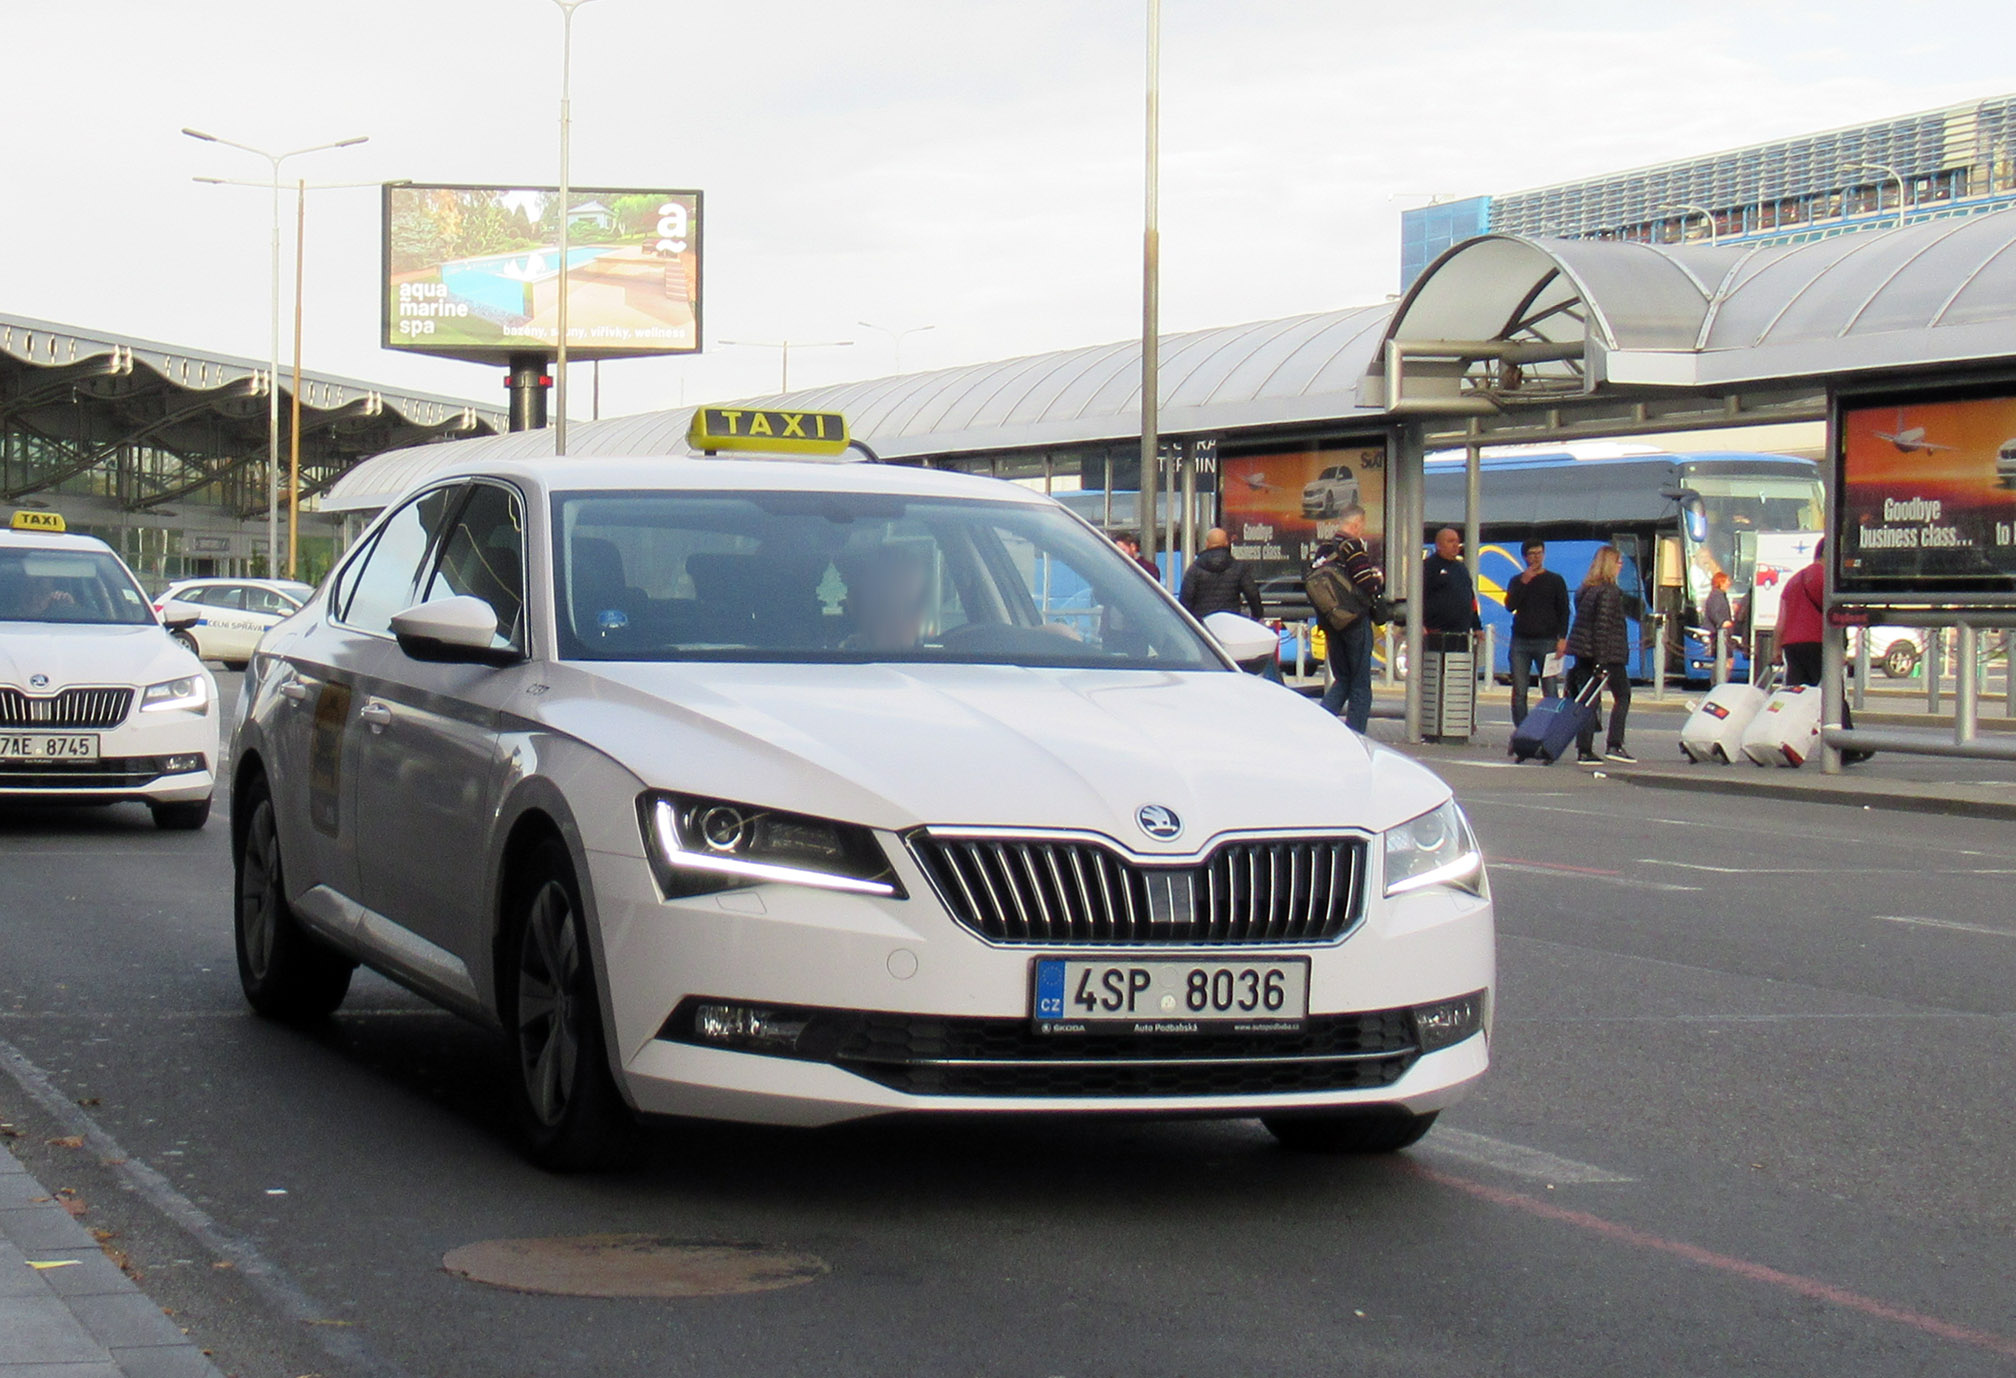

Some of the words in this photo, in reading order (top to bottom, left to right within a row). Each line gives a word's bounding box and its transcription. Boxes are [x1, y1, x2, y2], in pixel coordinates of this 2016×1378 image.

[400, 283, 448, 301] aqua
[400, 299, 468, 317] marine
[400, 319, 435, 337] spa
[551, 327, 587, 338] suny,
[635, 327, 685, 338] wellness
[721, 411, 825, 438] TAXI
[1884, 497, 1941, 523] Goodbye
[22, 514, 57, 526] TAXI
[1859, 525, 1917, 548] business
[1921, 523, 1973, 547] class...
[1996, 521, 2010, 545] to
[1, 738, 32, 755] 7AE
[46, 738, 89, 756] 8745
[1074, 968, 1151, 1012] 4SP
[1186, 968, 1285, 1012] 8036
[1041, 999, 1060, 1011] CZ
[1134, 1024, 1153, 1033] Auto
